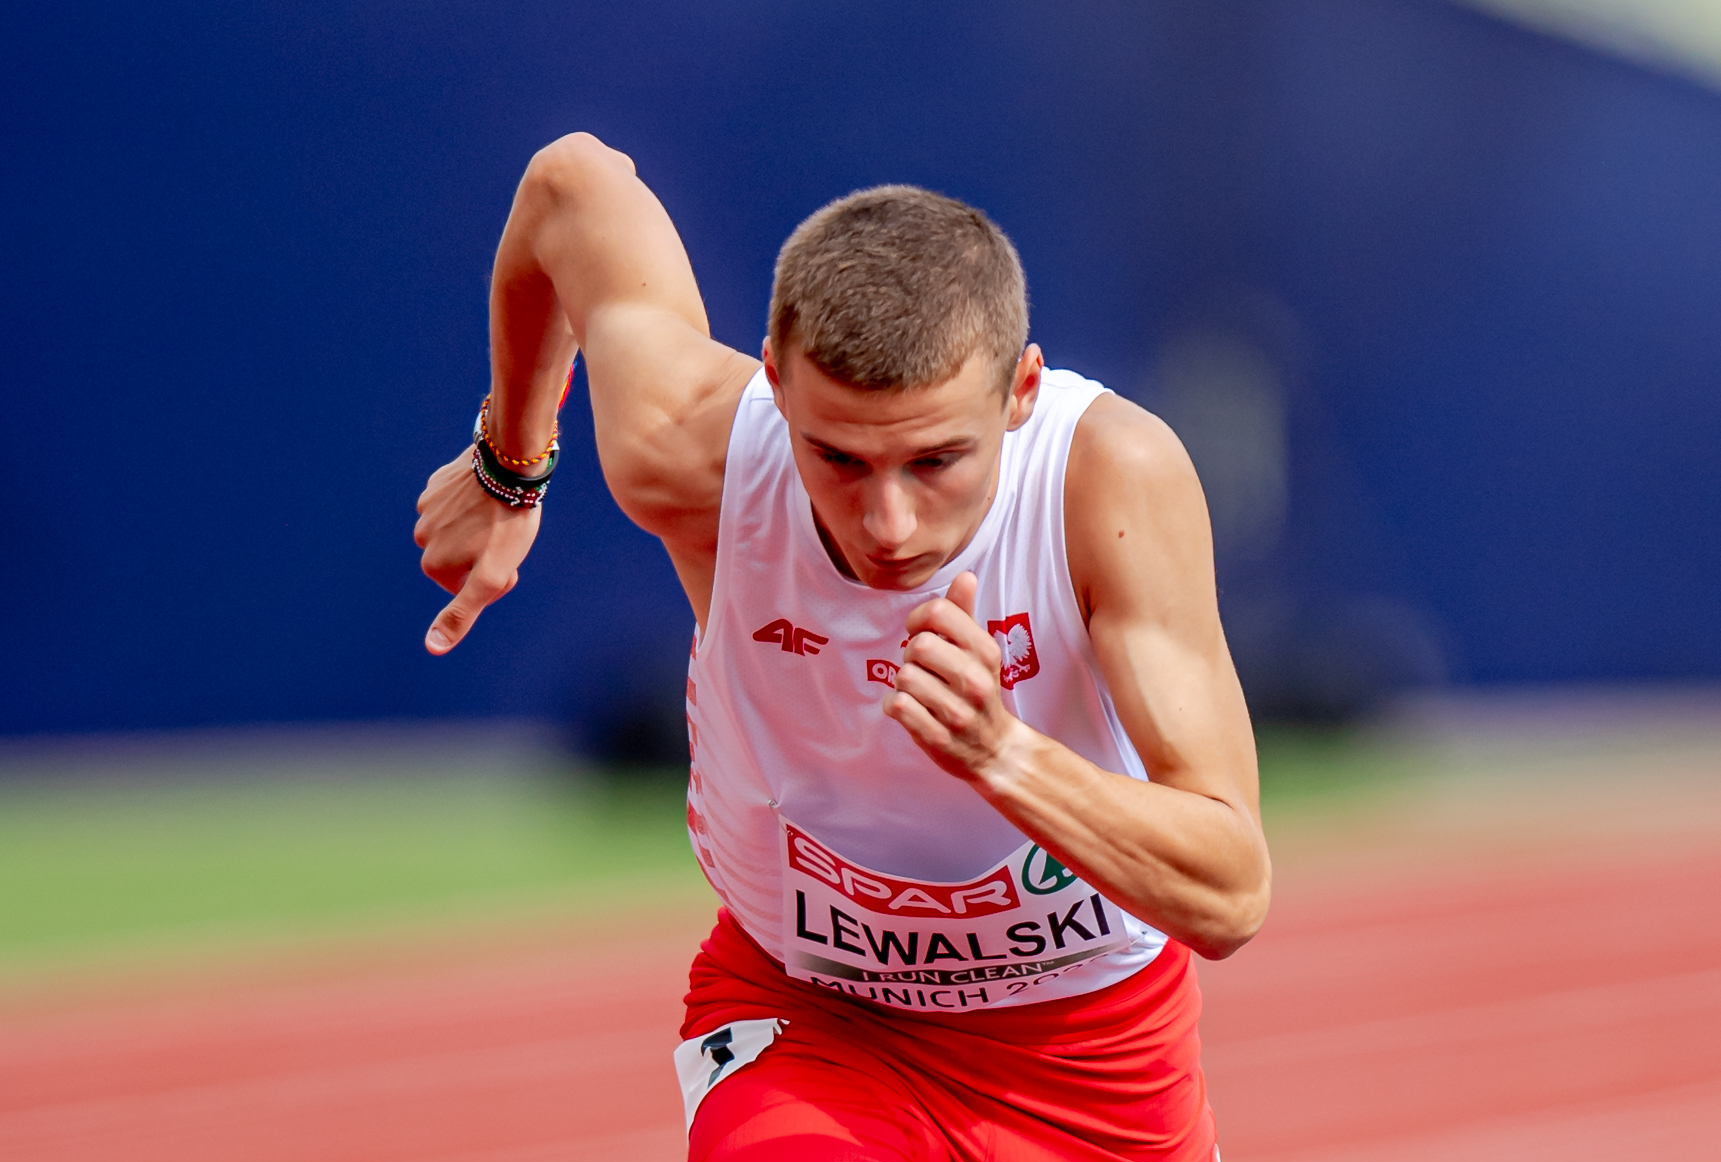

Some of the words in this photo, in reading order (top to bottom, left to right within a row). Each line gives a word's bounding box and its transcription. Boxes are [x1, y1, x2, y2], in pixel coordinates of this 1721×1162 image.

[794, 837, 1012, 915] SPAR
[796, 889, 1111, 966] LEWALSKI
[862, 971, 870, 982] I
[879, 970, 941, 984] RUN
